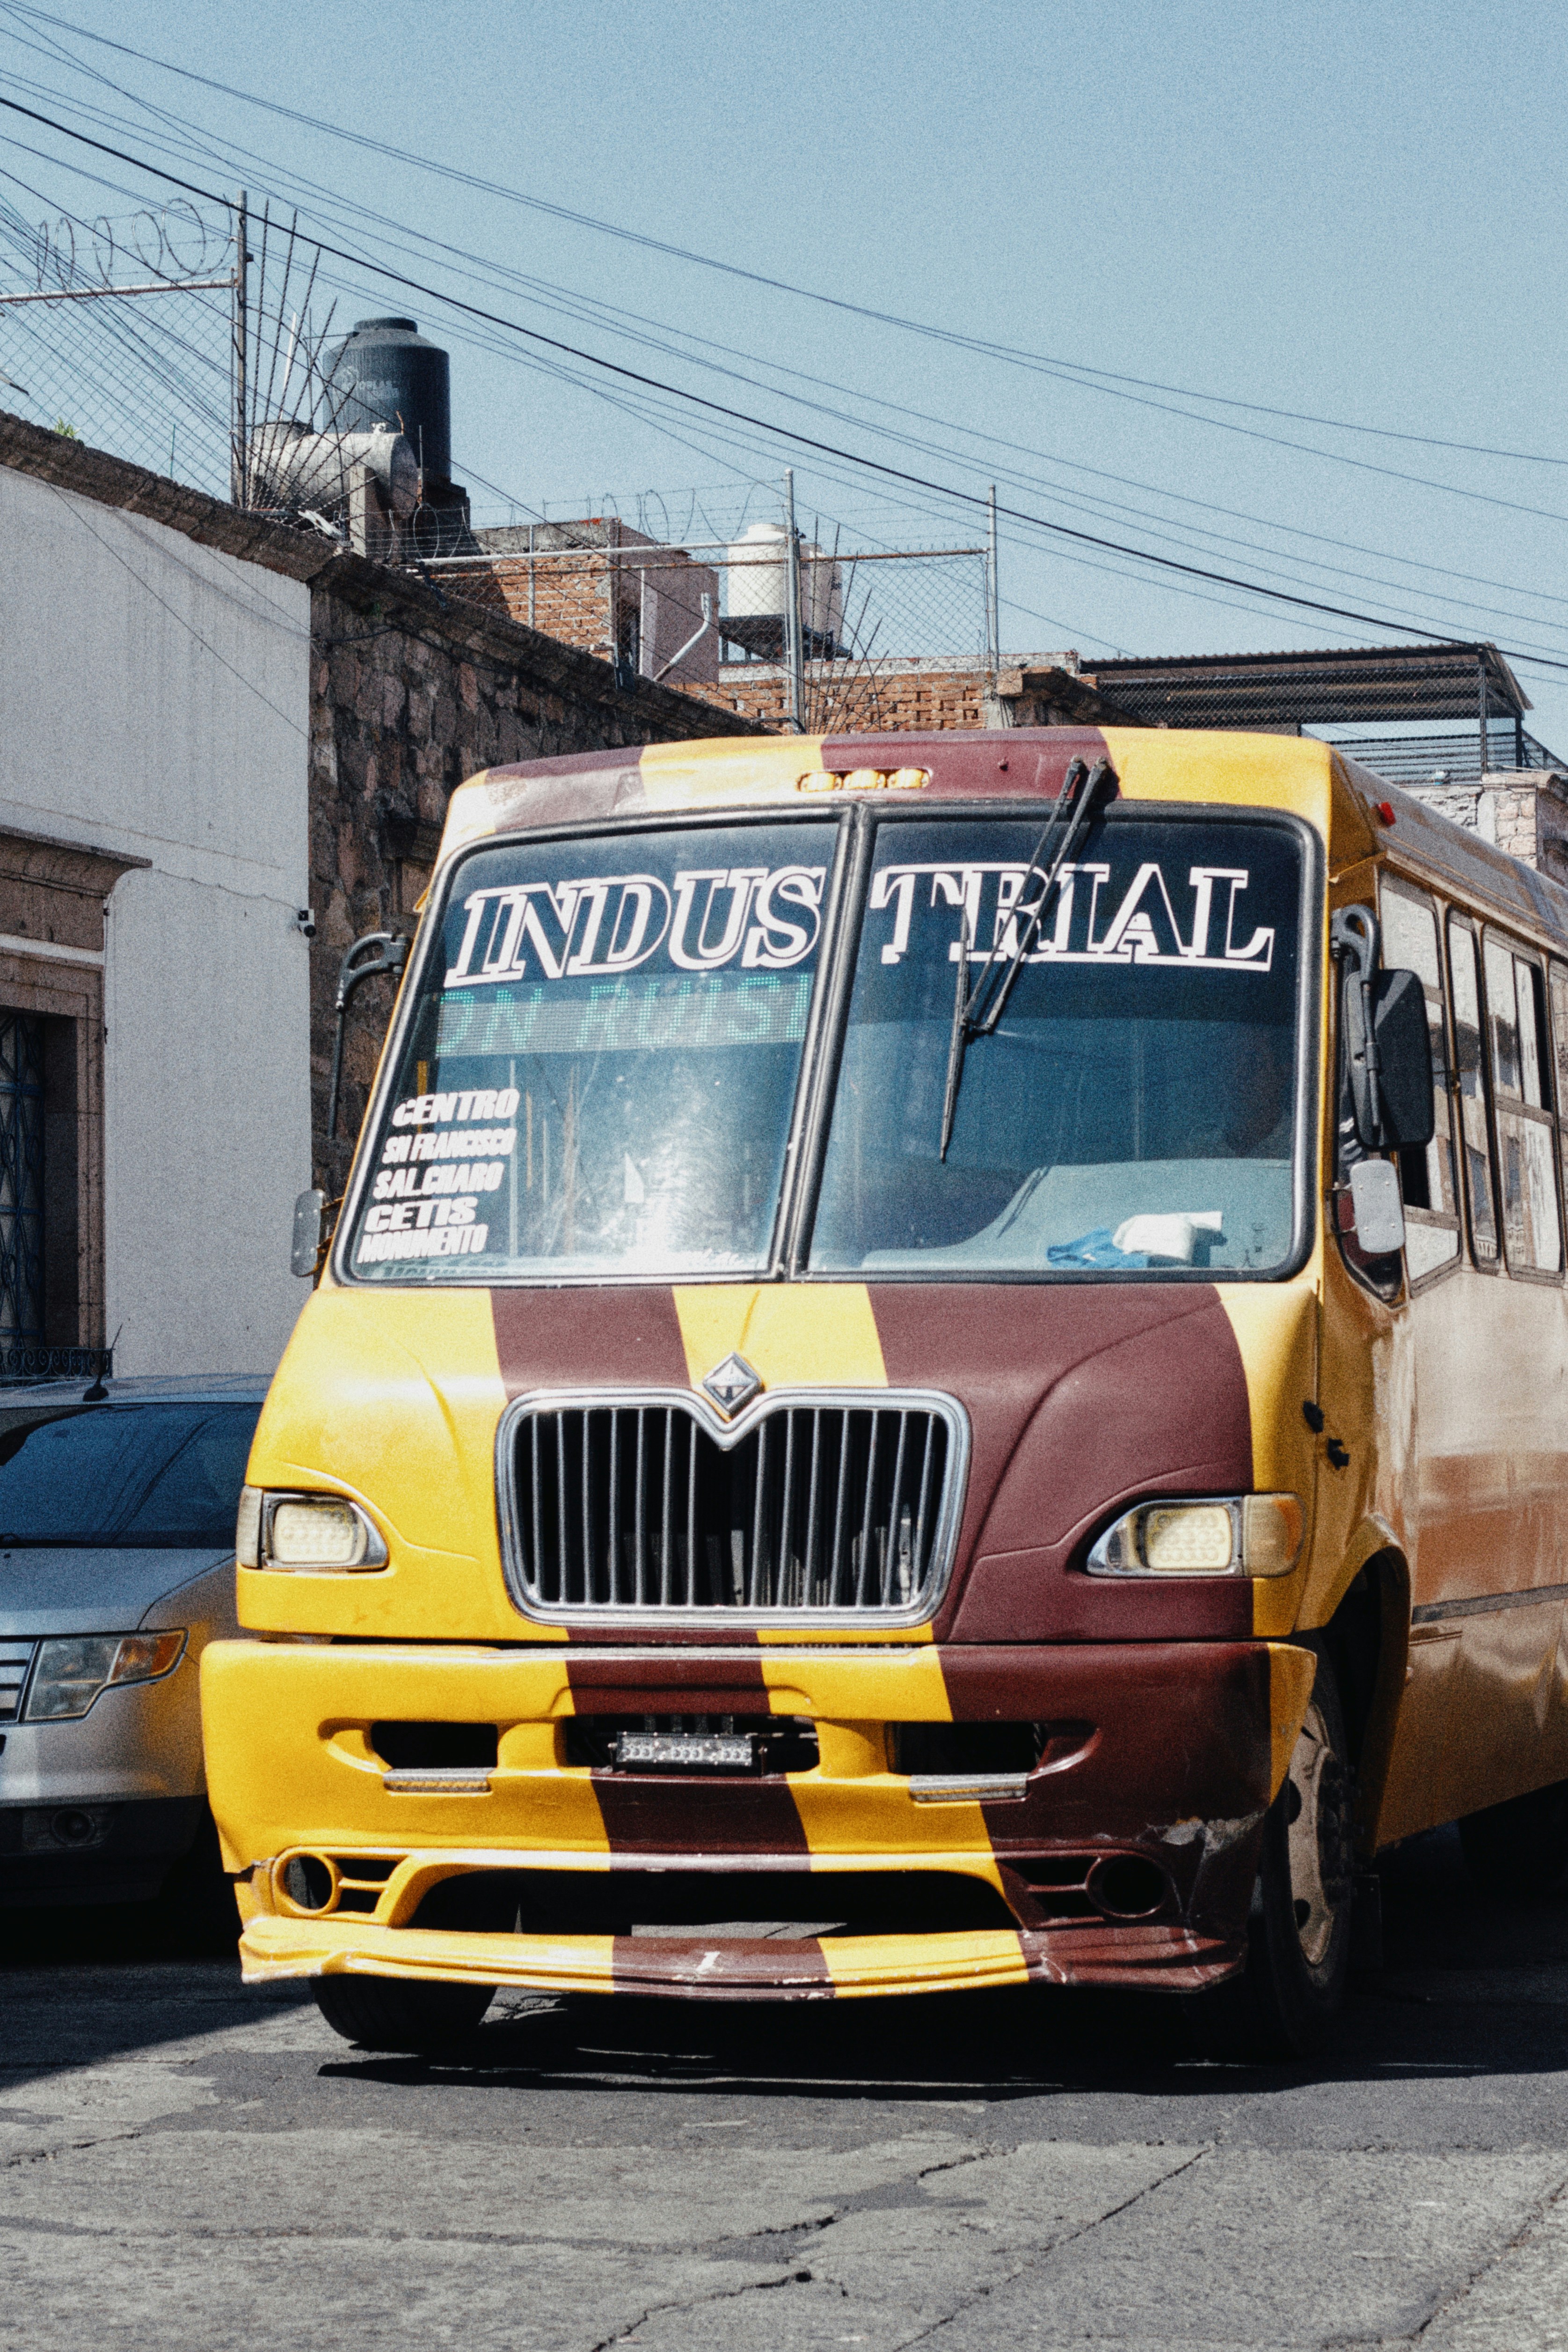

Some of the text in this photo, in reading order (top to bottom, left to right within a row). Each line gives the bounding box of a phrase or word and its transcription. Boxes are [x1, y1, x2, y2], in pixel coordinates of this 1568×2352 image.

[392, 1088, 520, 1127] CENTRO
[409, 1127, 517, 1162] FRANCISCO
[364, 1196, 478, 1232] CETIS
[357, 1223, 489, 1264] MONUMENTO
